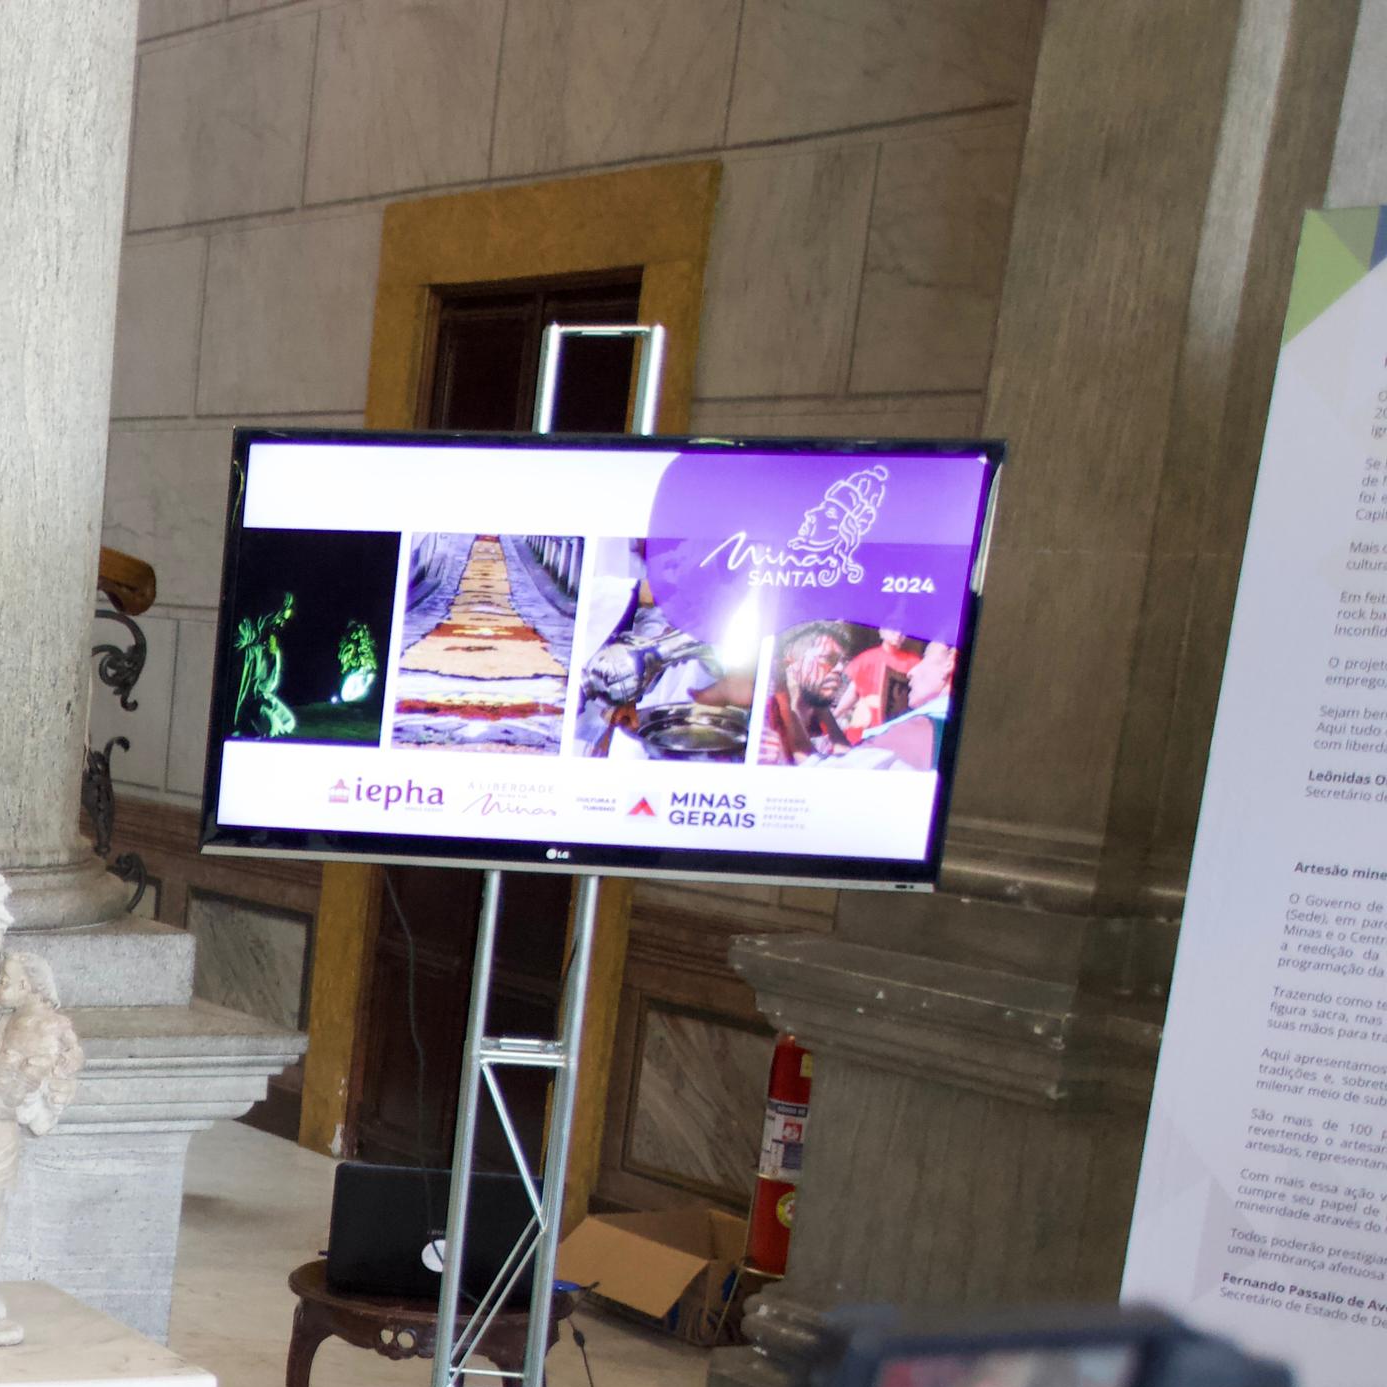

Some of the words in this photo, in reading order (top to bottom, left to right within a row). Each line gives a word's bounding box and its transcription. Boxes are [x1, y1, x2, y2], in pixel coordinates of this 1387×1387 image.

[1362, 474, 1378, 487] de
[700, 531, 837, 570] Minas
[1349, 541, 1380, 554] Mais
[748, 571, 817, 587] SANTA
[881, 578, 935, 593] 2024
[1340, 591, 1361, 603] Em
[1337, 608, 1365, 620] rock
[1329, 656, 1339, 668] O
[1319, 705, 1359, 721] Sejam
[1316, 722, 1347, 736] Aqui
[1350, 724, 1381, 737] tudo
[1313, 740, 1342, 751] com
[1308, 770, 1370, 785] Leônidas
[355, 777, 444, 810] iepha
[671, 792, 746, 809] MINAS
[1305, 786, 1371, 802] Secretário
[669, 810, 755, 828] GERAIS
[1294, 861, 1348, 877] Artesão
[1289, 893, 1300, 905] O
[1305, 894, 1361, 911] Governo
[1367, 900, 1384, 913] de
[1335, 916, 1356, 927] em
[1283, 925, 1322, 939] Minas
[1326, 932, 1333, 940] e
[1338, 932, 1346, 942] o
[1350, 932, 1387, 945] Centr
[1280, 942, 1288, 951] a
[1298, 942, 1353, 959] reedição
[1363, 949, 1379, 961] da
[1277, 957, 1364, 977] programação
[1368, 966, 1385, 978] da
[1273, 986, 1332, 1003] Trazendo
[1336, 995, 1372, 1009] como
[1270, 1002, 1307, 1017] figura
[1312, 1008, 1348, 1023] sacra,
[1355, 1013, 1383, 1026] mas
[1267, 1018, 1296, 1031] suas
[1299, 1022, 1334, 1036] mãos
[1337, 1026, 1367, 1040] para
[1261, 1048, 1290, 1062] Aqui
[1259, 1064, 1317, 1081] tradições
[1256, 1080, 1304, 1095] milenar
[1307, 1088, 1340, 1100] meio
[1343, 1091, 1360, 1103] de
[1251, 1108, 1274, 1122] São
[1283, 1114, 1313, 1128] mais
[1322, 1119, 1339, 1131] de
[1349, 1123, 1373, 1136] 100
[1247, 1125, 1318, 1144] revertendo
[1325, 1137, 1333, 1146] o
[1245, 1140, 1301, 1158] artesãos,
[1240, 1168, 1269, 1182] Com
[1275, 1175, 1304, 1188] mais
[1310, 1182, 1338, 1193] essa
[1344, 1186, 1374, 1200] ação
[1237, 1184, 1286, 1201] cumpre
[1292, 1194, 1314, 1206] seu
[1321, 1199, 1357, 1213] papel
[1363, 1205, 1380, 1217] de
[1235, 1200, 1310, 1220] mineiridade
[1313, 1213, 1361, 1229] através
[1364, 1220, 1381, 1232] do
[1230, 1227, 1267, 1244] Todos
[1271, 1236, 1324, 1254] poderão
[1227, 1245, 1255, 1257] uma
[1258, 1248, 1325, 1271] lembrança
[1328, 1262, 1385, 1281] afetuosa
[1222, 1272, 1285, 1293] Fernando
[1289, 1285, 1344, 1304] Passalio
[1347, 1296, 1364, 1308] de
[1220, 1287, 1282, 1308] Secretário
[1285, 1300, 1301, 1312] de
[1305, 1304, 1348, 1321] Estado
[1351, 1313, 1367, 1324] de
